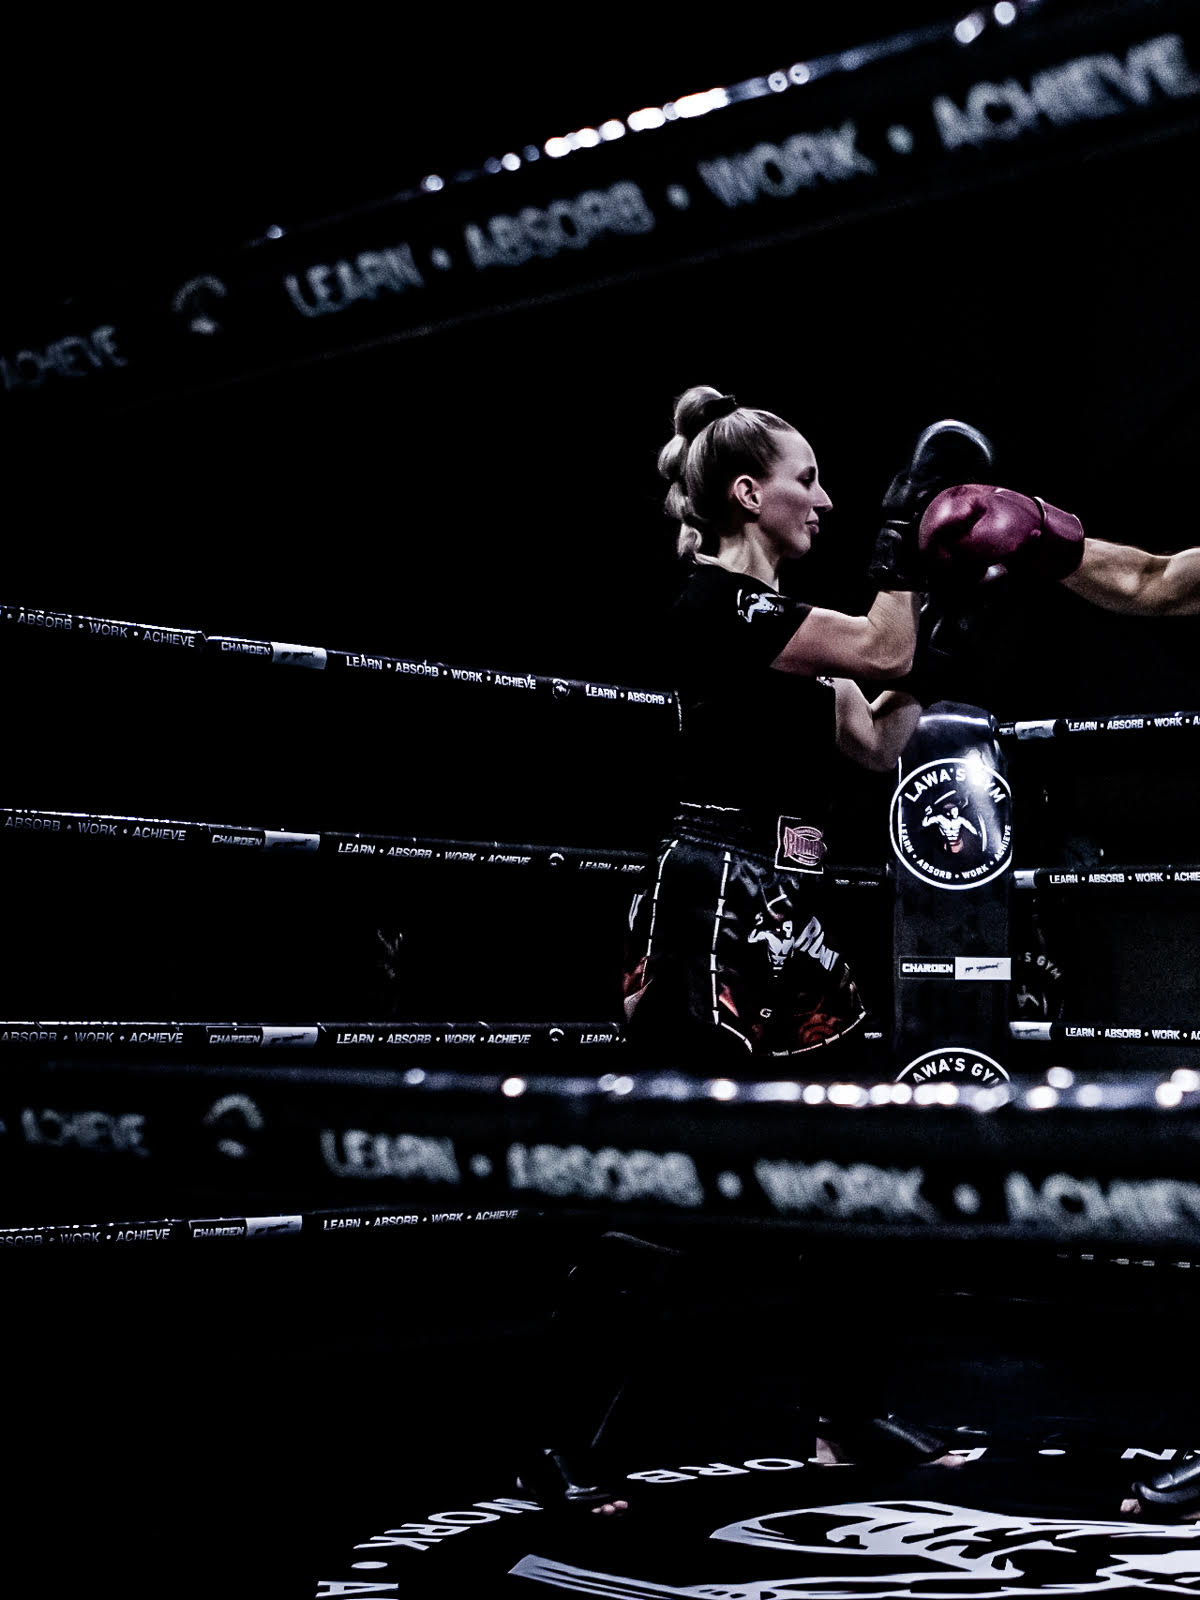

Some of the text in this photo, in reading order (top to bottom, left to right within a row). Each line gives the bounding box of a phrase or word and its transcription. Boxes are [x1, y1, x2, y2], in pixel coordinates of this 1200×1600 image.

[697, 120, 878, 208] WORK
[17, 612, 73, 632] ABSORB
[89, 621, 128, 638] WORK
[143, 629, 195, 648] ACHIEVE
[346, 655, 536, 689] LEARN ABSORB WORK ACHIEVE
[585, 684, 665, 705] LEARN ABSORB
[1068, 720, 1097, 731] LEARN
[1107, 719, 1144, 730] ABSORB
[1154, 717, 1182, 728] WORK
[904, 767, 968, 803] LAWA'S
[4, 816, 187, 841] ABSORB WORK ACHIEVE
[338, 842, 532, 866] LEARN ABSORB WORK ACHIEVE
[961, 863, 989, 879] WORK
[1049, 873, 1078, 884] LEARN
[1088, 873, 1125, 883] ABSORB
[1135, 872, 1164, 882] WORK
[0, 1032, 183, 1044] ABSORB WORK ACHIEVE
[336, 1033, 532, 1045] LEARN ABSORB WORK ACHIEVE
[580, 1034, 612, 1045] LEARN
[1065, 1028, 1095, 1038] LEARN
[1104, 1028, 1141, 1039] ABSORB
[1152, 1029, 1180, 1040] WORK
[912, 1057, 966, 1084] AWA'S
[323, 1209, 519, 1230] LEARN ABSORB WORK ACHIEVE
[60, 1232, 101, 1245] WORK
[116, 1229, 170, 1242] ACHIEVE
[352, 1497, 545, 1551] WORK
